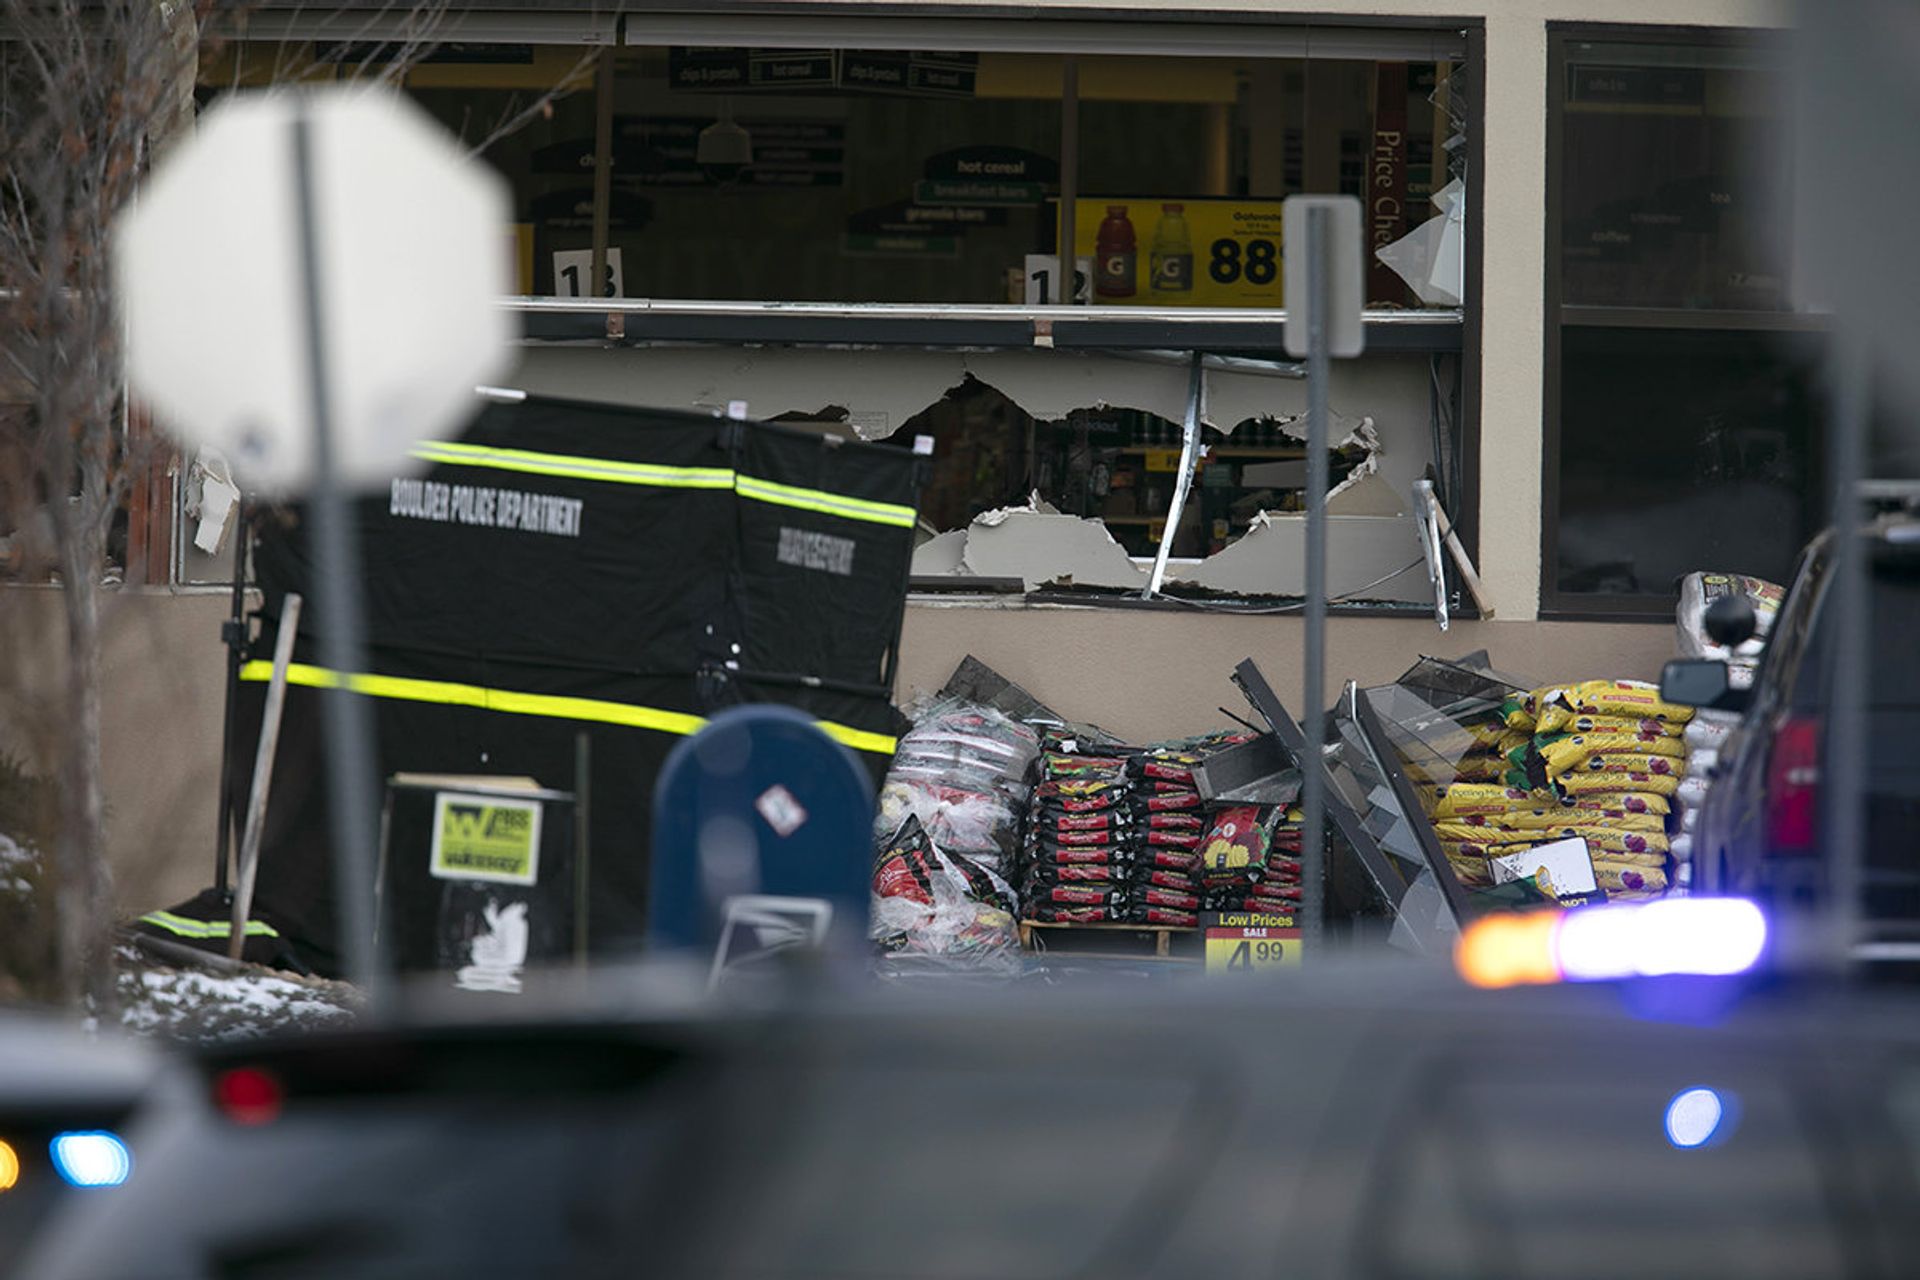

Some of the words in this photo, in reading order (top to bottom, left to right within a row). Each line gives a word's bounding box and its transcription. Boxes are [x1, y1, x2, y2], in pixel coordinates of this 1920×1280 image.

[957, 159, 982, 174] hot
[984, 160, 1025, 174] cereal
[1375, 131, 1400, 188] Price
[1374, 196, 1400, 269] Che
[1107, 257, 1125, 275] G
[1163, 257, 1180, 276] G
[1209, 238, 1284, 284] 88
[390, 477, 450, 522] BOULDER
[450, 485, 498, 527] POLICE
[496, 489, 584, 537] DEPARTMENT
[1452, 788, 1484, 800] Potting
[1219, 912, 1248, 926] Low
[1250, 912, 1294, 927] Prices
[1243, 927, 1267, 937] SALE
